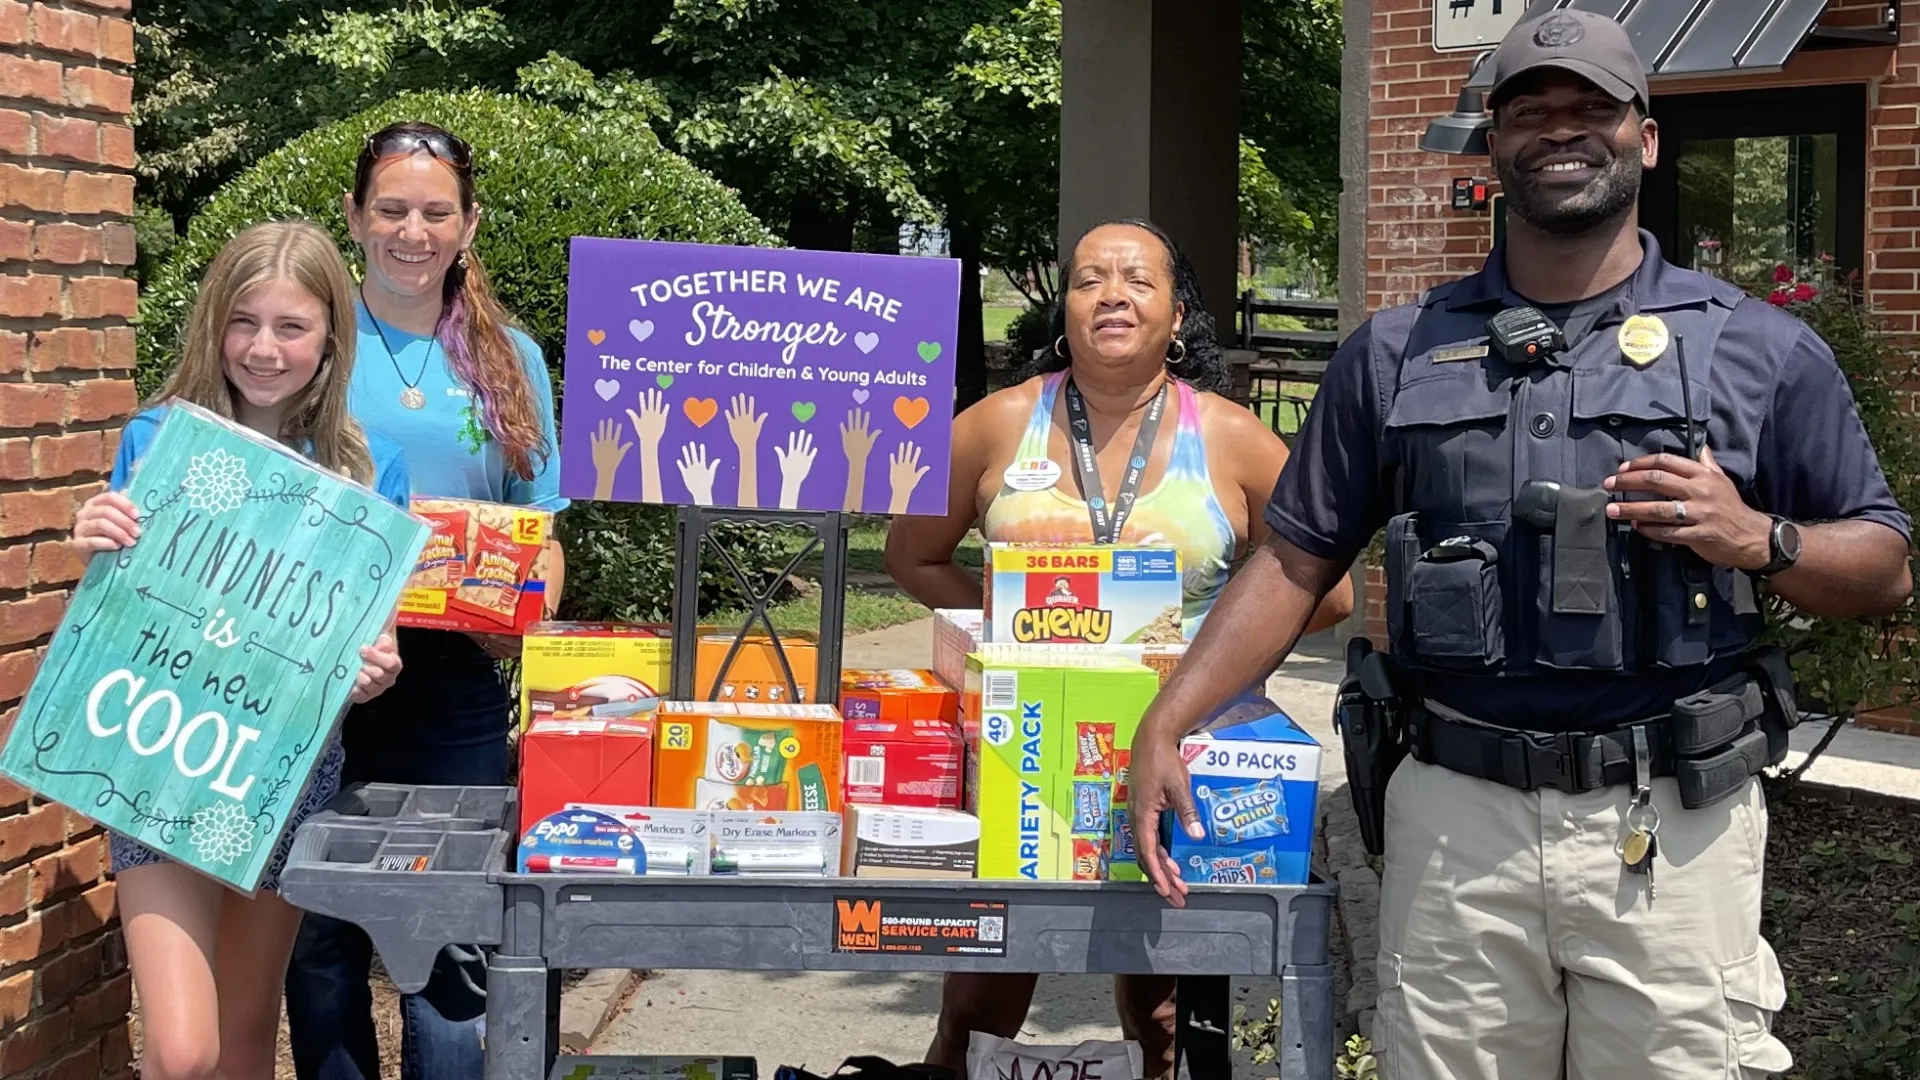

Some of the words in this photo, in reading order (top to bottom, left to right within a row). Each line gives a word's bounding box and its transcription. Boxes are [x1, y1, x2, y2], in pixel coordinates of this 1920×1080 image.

[630, 269, 787, 307] TOGETHER
[796, 272, 841, 303] WE
[844, 287, 903, 323] ARE
[685, 301, 847, 364] Stronger
[599, 355, 631, 371] The
[636, 357, 693, 375] Center
[698, 358, 724, 376] for
[727, 362, 797, 380] Children
[801, 366, 814, 381] &
[818, 367, 871, 387] Young
[874, 370, 927, 387] Adults
[517, 518, 540, 535] 12
[158, 509, 345, 639] KINDNESS
[480, 549, 520, 574] Animal
[1026, 555, 1048, 568] 36
[1051, 555, 1100, 568] BARS
[203, 607, 241, 649] is
[131, 621, 194, 679] the
[202, 670, 272, 717] new
[86, 668, 263, 802] COOL
[668, 725, 684, 748] 20
[988, 715, 1004, 744] 40
[1021, 700, 1043, 773] PACK
[1206, 751, 1230, 766] 30
[1237, 752, 1297, 770] PACKS
[803, 782, 819, 811] EESE
[1199, 787, 1209, 797] 15
[1214, 790, 1278, 822] OREO
[1232, 804, 1274, 829] mini
[535, 821, 579, 841] EXPO
[643, 823, 685, 835] Markers
[722, 827, 741, 839] Dry
[744, 827, 773, 837] Erase
[775, 827, 818, 837] Markers
[1019, 782, 1041, 879] ARIETY
[881, 916, 932, 926] 500-POUND
[933, 918, 978, 927] CAPACITY
[881, 926, 938, 937] SERVICE
[941, 927, 977, 939] CART
[841, 933, 876, 947] WEN
